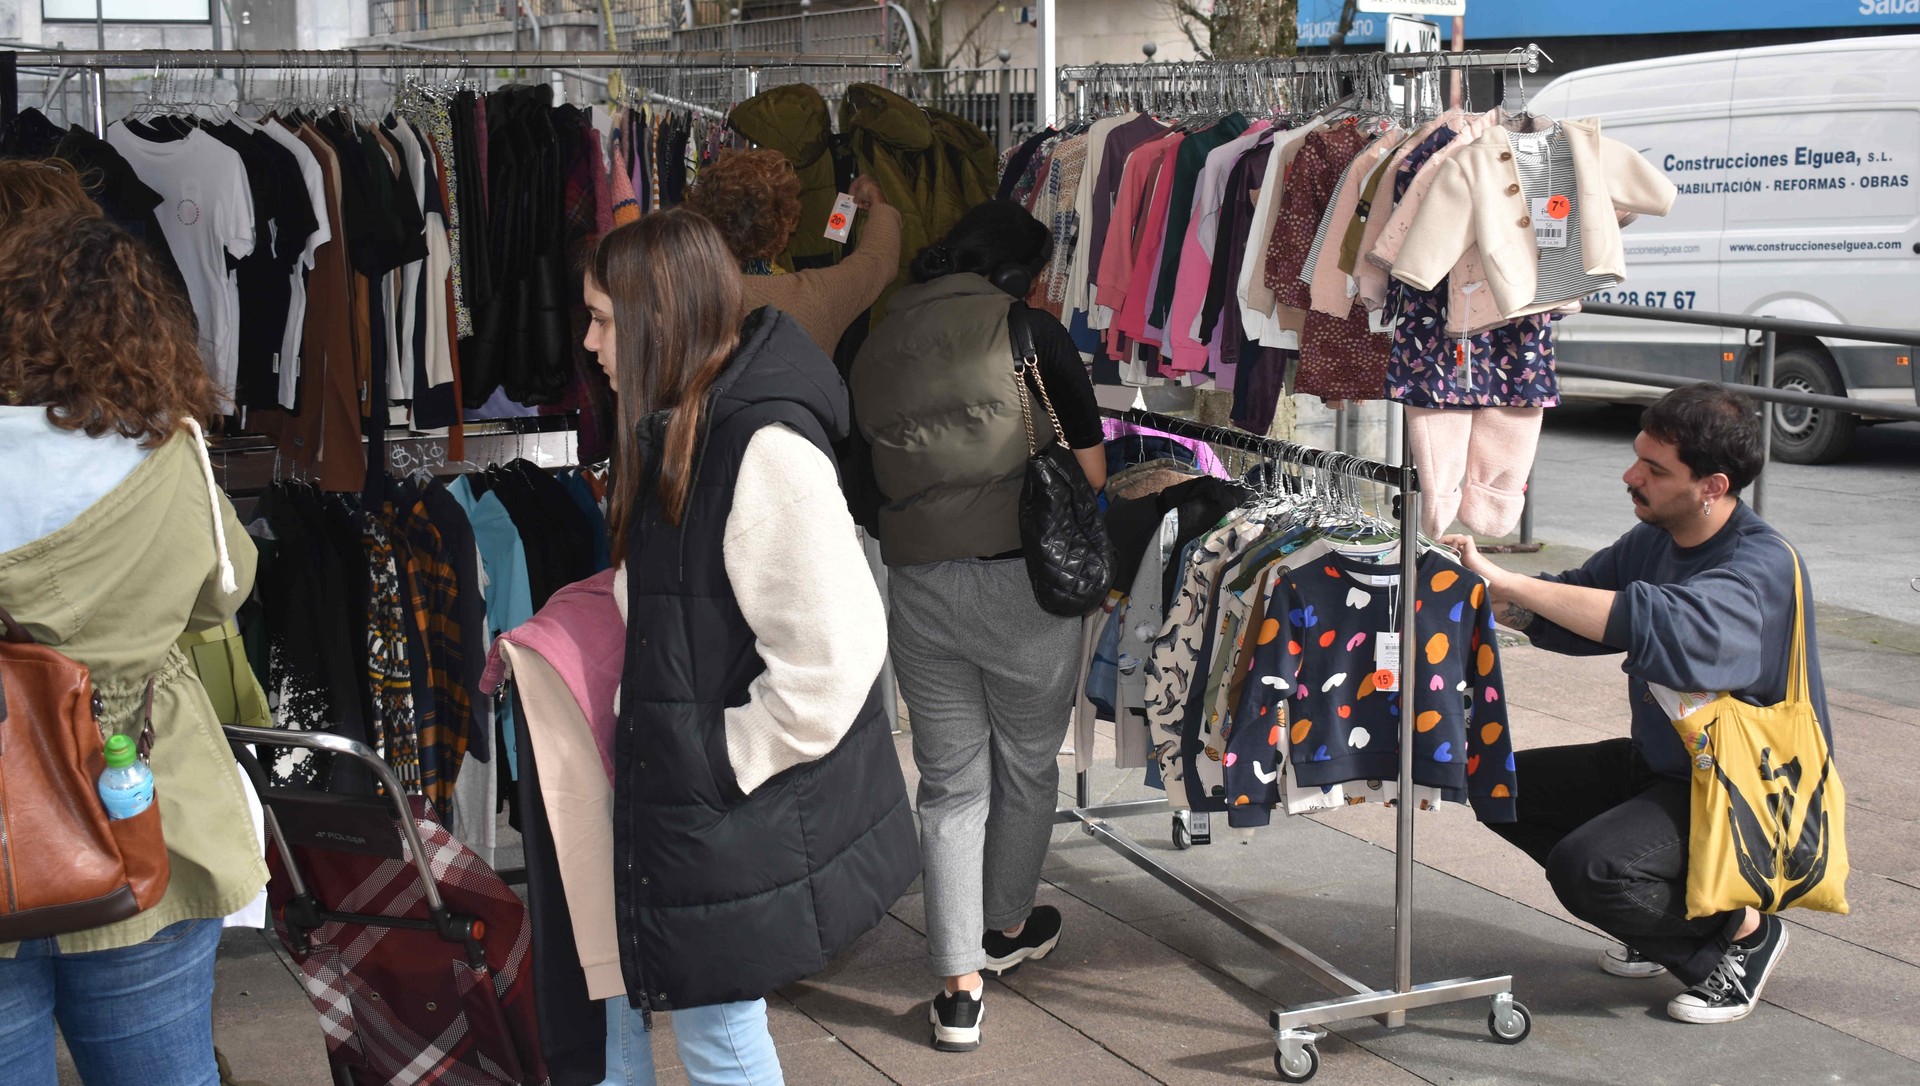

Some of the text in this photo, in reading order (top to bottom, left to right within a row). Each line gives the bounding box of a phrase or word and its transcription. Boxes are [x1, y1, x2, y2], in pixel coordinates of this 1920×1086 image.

[1663, 153, 1788, 172] Construcciones
[1795, 147, 1861, 169] Elguea,
[1675, 174, 1909, 195] HABILITACIÓN REFORMAS OBRAS
[1624, 243, 1700, 256] ruccioneselguea.com
[1729, 240, 1901, 252] www.construccioneselguea.com
[1618, 291, 1639, 306] 28
[1645, 291, 1667, 309] 67
[1674, 290, 1696, 309] 67
